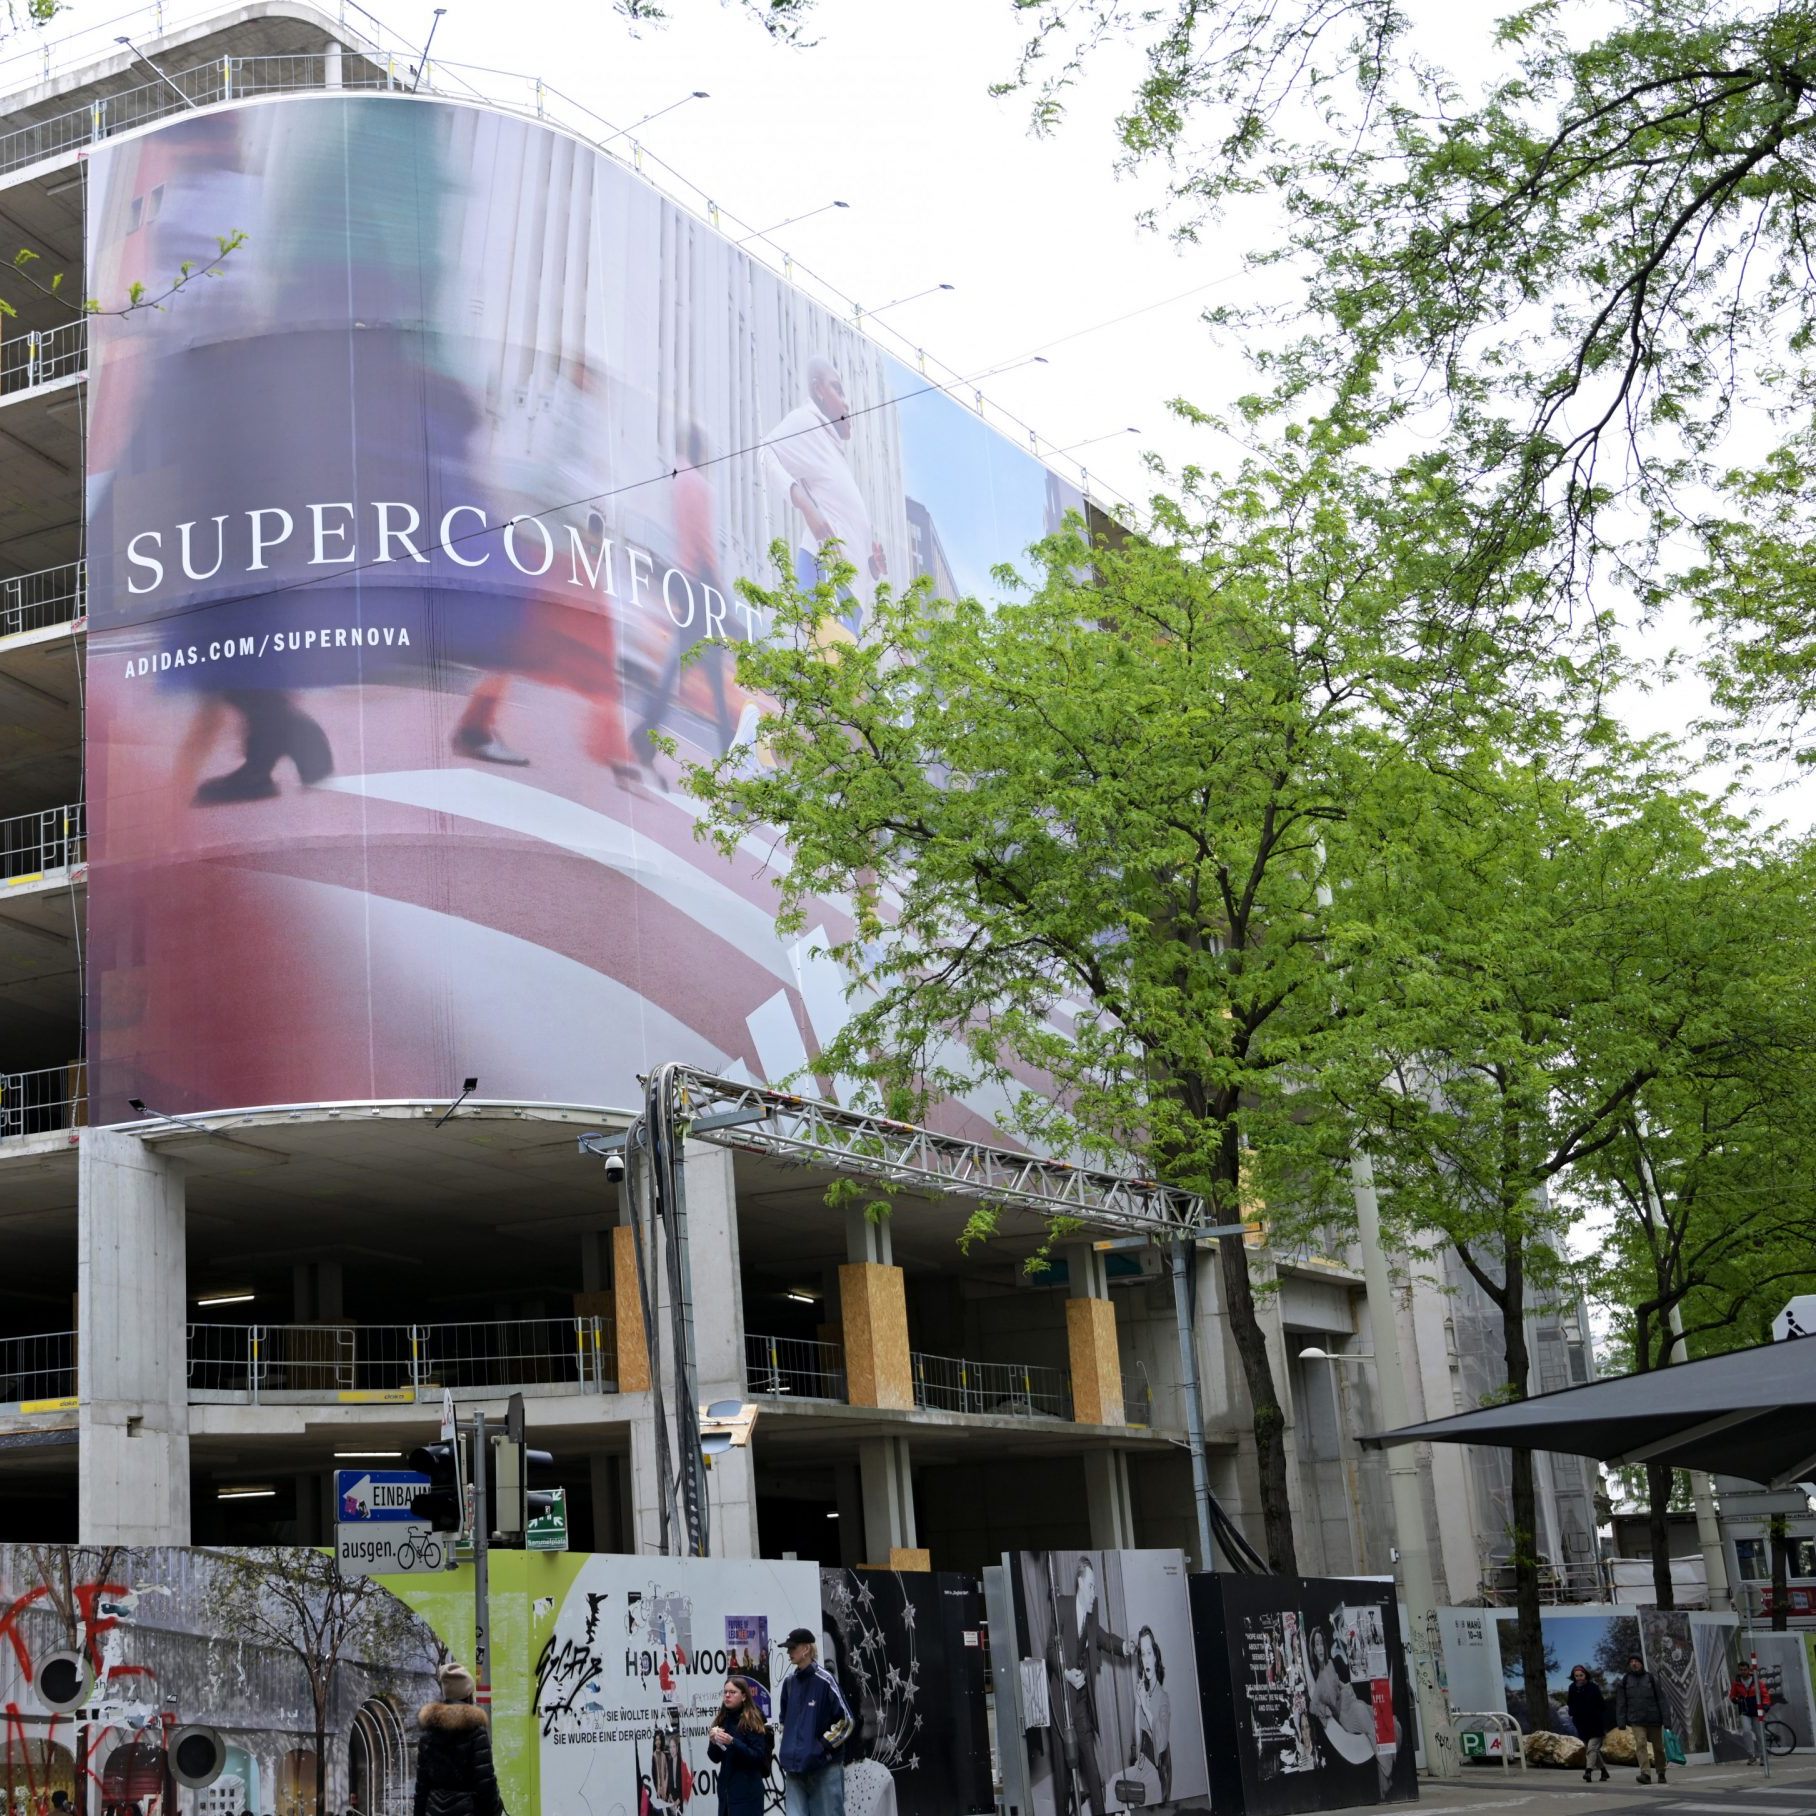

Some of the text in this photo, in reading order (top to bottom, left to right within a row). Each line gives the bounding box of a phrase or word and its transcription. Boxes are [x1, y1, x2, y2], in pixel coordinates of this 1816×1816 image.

[126, 502, 763, 646] SUPERCOMFORT
[125, 628, 410, 678] ADIDAS.COM/SUPERNOVA
[342, 1541, 396, 1563] ausgen.
[606, 1710, 619, 1722] SIE
[621, 1709, 650, 1721] WOLLTE
[651, 1708, 659, 1720] IN
[553, 1733, 567, 1745] SIE
[568, 1731, 598, 1744] WURDE
[599, 1730, 617, 1742] EINE
[618, 1729, 634, 1741] DER
